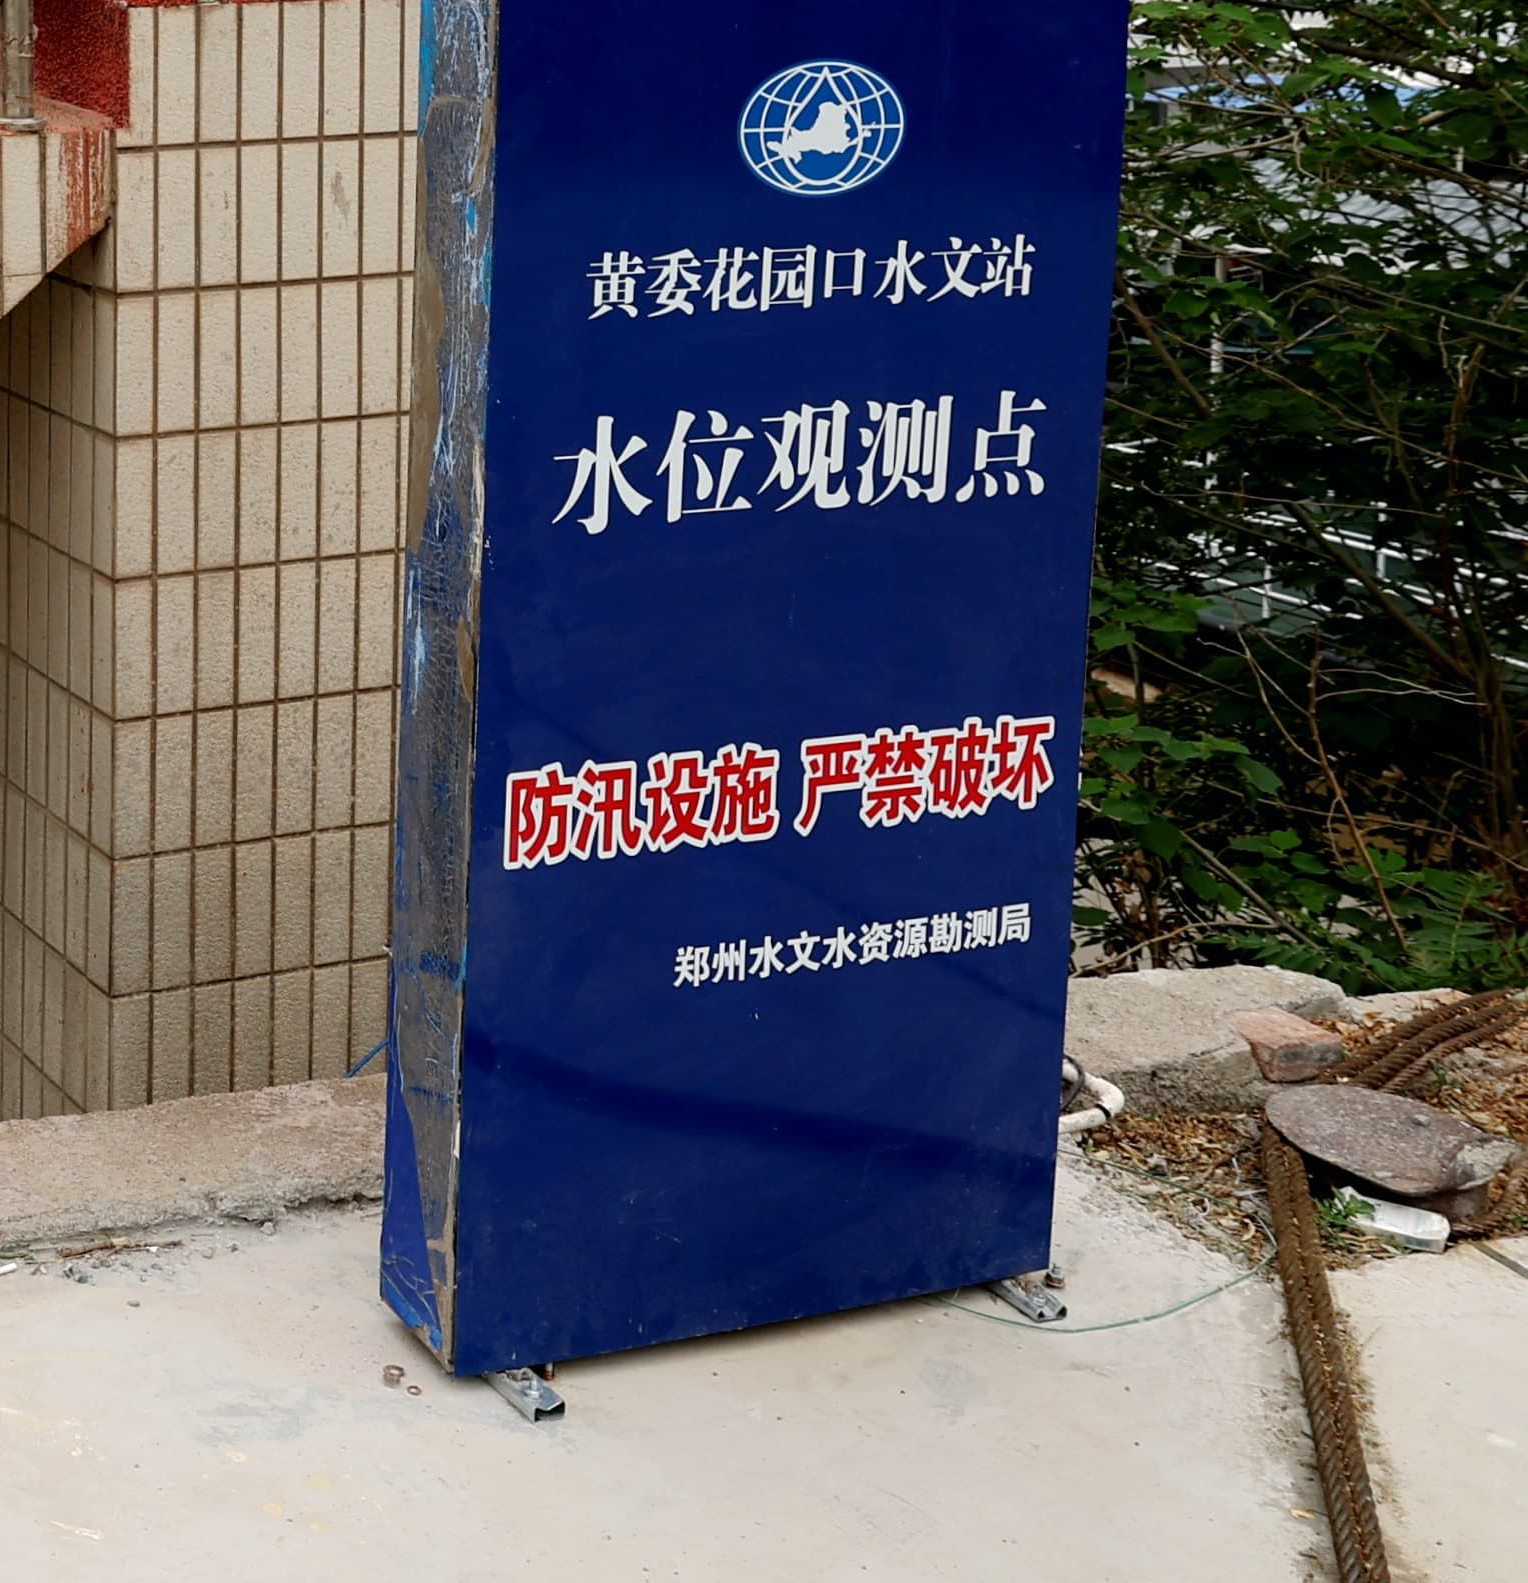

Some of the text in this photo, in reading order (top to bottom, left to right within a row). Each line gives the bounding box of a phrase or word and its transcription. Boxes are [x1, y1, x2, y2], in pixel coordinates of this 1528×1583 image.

[586, 233, 1036, 320] 黄委花园口水文站
[551, 390, 1047, 535] 水位观测点
[504, 715, 1055, 870] 防汛设施 严禁破坏
[673, 902, 1031, 988] 郑州水文水资源勘测局
